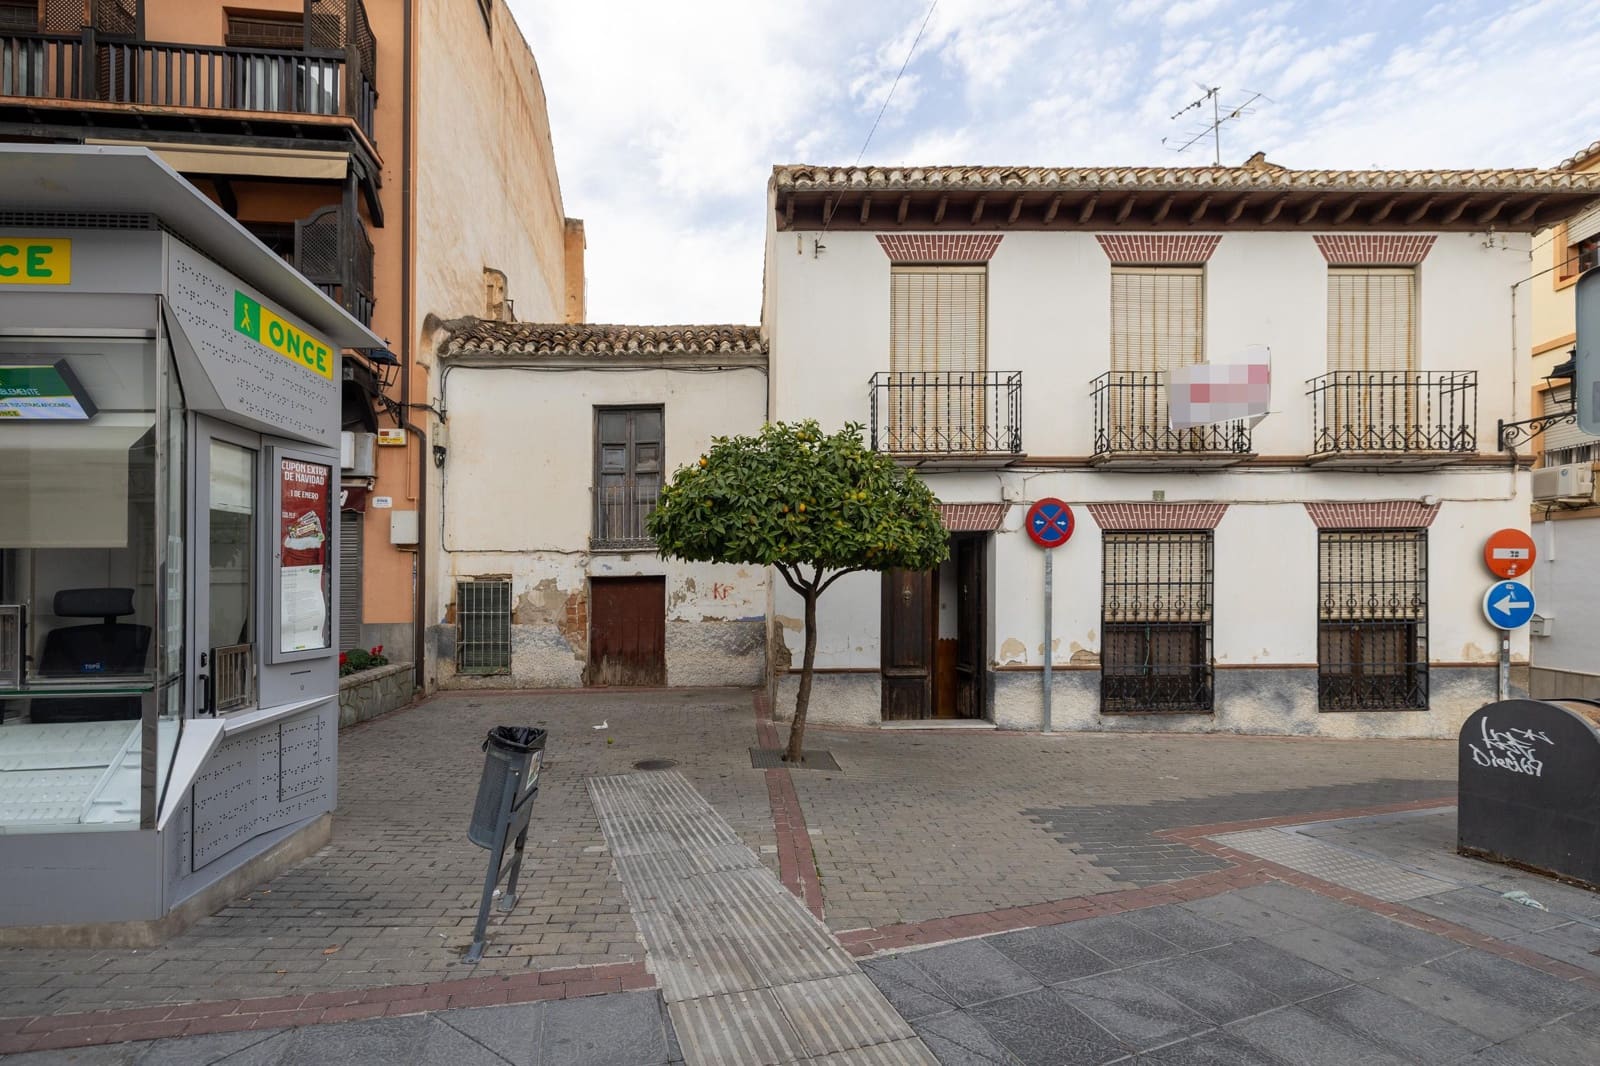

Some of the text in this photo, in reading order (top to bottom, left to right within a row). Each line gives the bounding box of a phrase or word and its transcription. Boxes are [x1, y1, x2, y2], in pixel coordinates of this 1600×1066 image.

[0, 245, 53, 277] CE
[268, 320, 327, 373] ONCE
[306, 465, 328, 476] EXTRA
[284, 471, 325, 485] DE NAVIDAD
[294, 490, 301, 498] DE
[301, 491, 319, 500] ENERO
